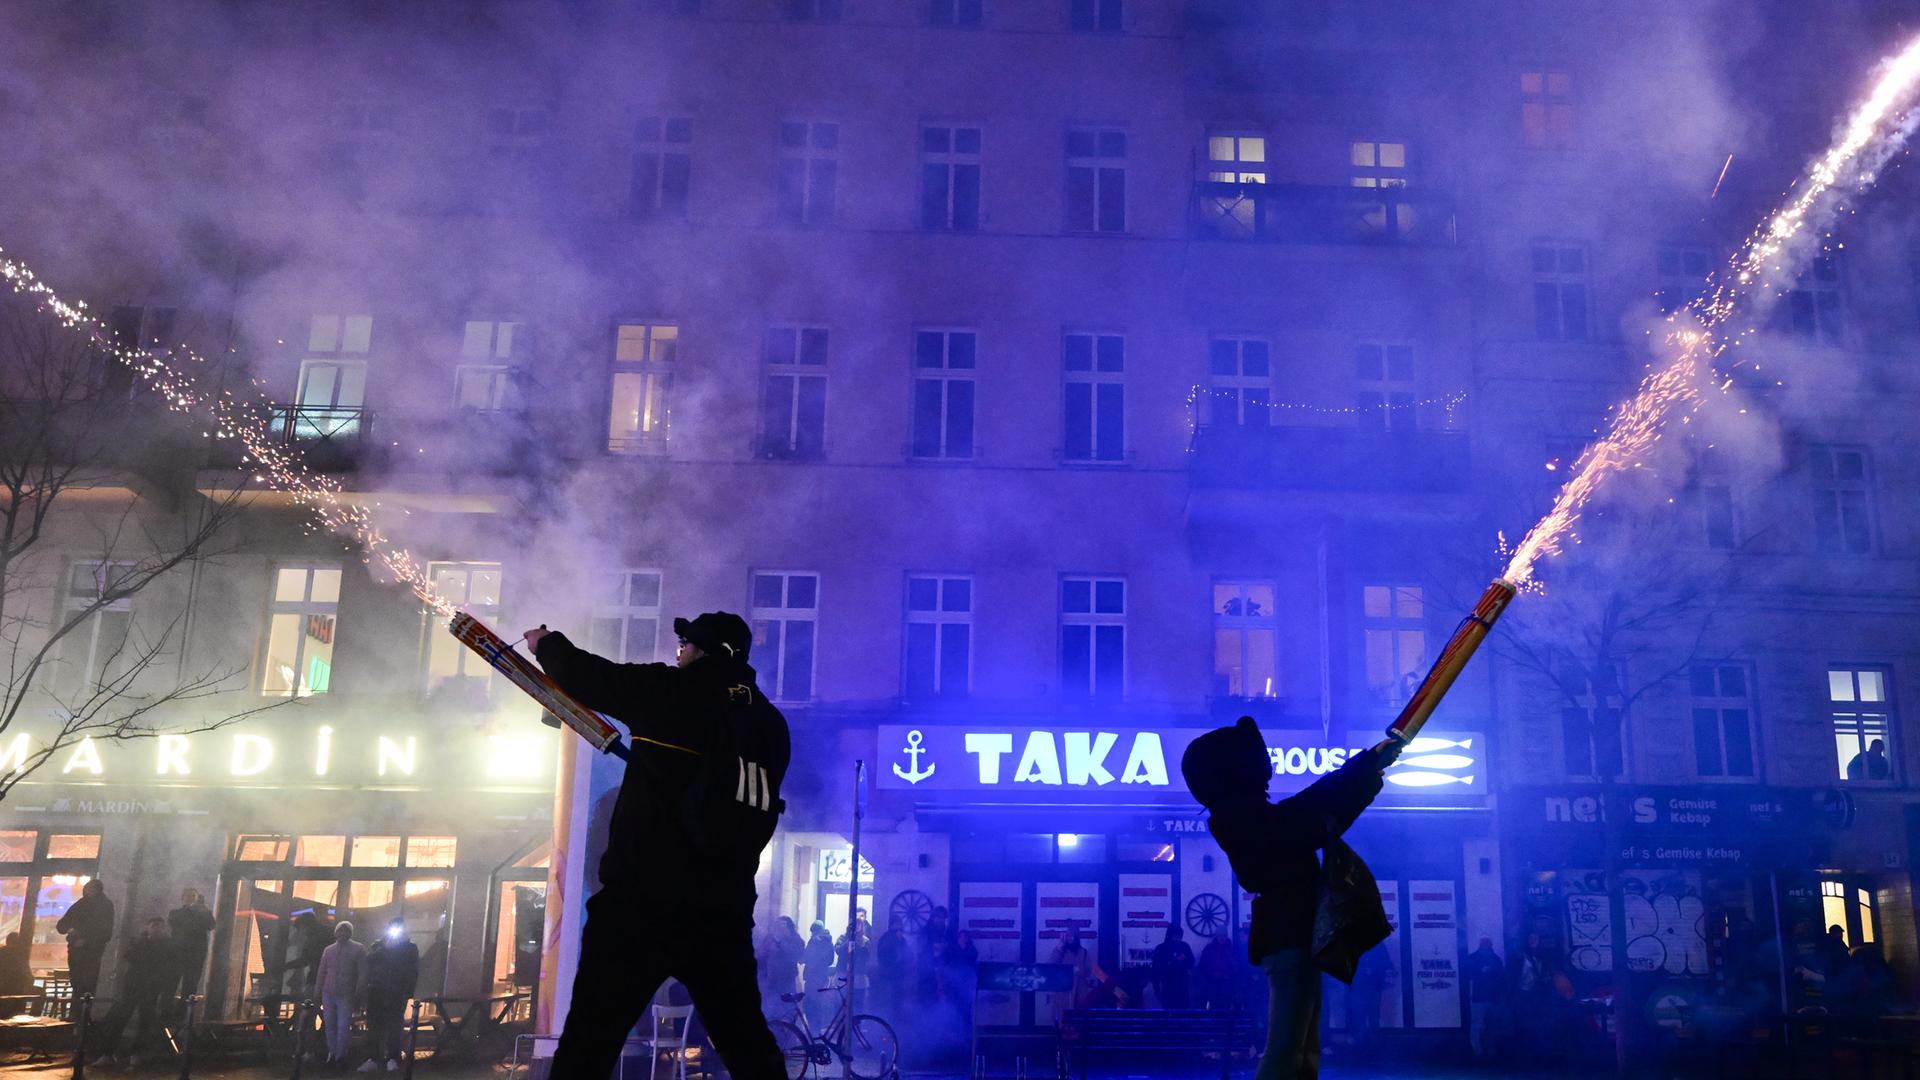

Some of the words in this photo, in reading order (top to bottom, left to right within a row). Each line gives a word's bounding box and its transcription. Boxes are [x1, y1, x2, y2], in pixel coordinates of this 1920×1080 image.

[964, 731, 1169, 787] TAKA
[1266, 746, 1362, 775] HOUS
[1669, 797, 1718, 811] Gemüse
[1163, 820, 1206, 832] TAKA
[1670, 811, 1712, 828] Kebap
[1655, 847, 1703, 859] Gemüse
[1706, 847, 1741, 863] Kebap
